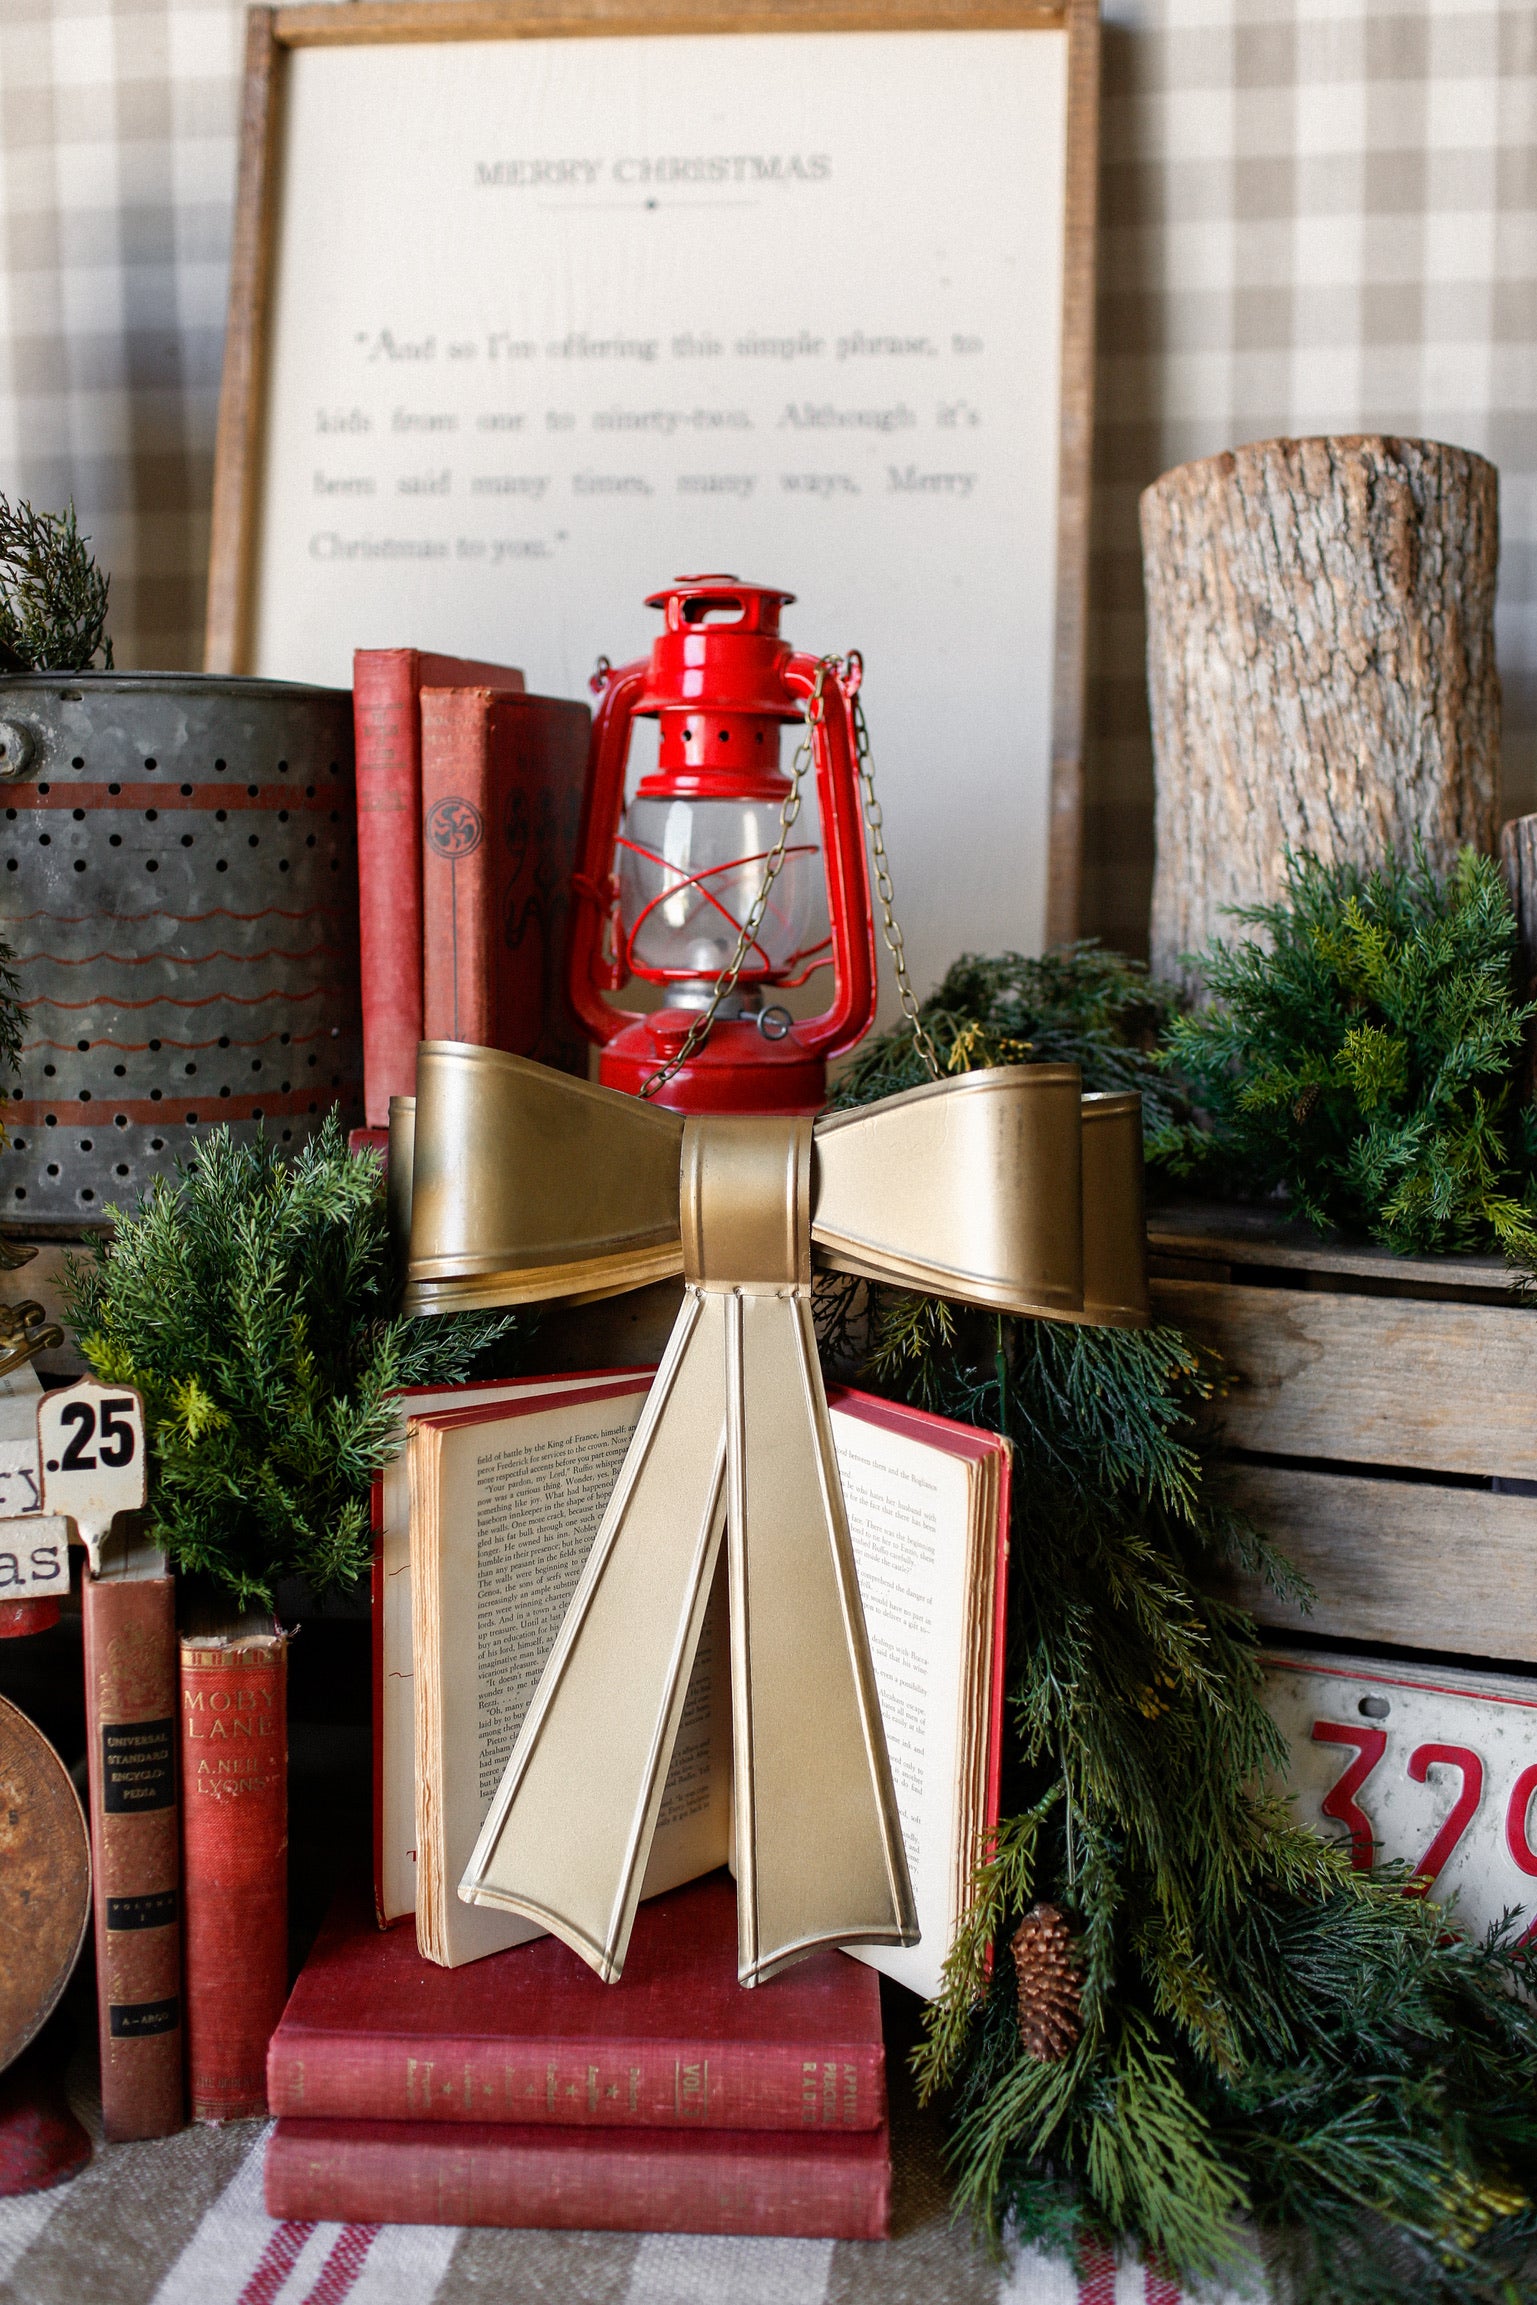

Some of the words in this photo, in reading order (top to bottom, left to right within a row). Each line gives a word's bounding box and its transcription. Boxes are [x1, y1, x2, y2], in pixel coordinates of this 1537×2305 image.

[475, 158, 602, 187] MERRY
[611, 153, 832, 185] CHRISTMAS
[447, 342, 478, 361] so
[488, 331, 537, 361] I'm
[546, 330, 659, 363] offering
[671, 330, 723, 357] this
[733, 330, 826, 361] simple
[835, 329, 938, 362] phrase,
[951, 334, 984, 355] to
[315, 406, 371, 433] kids
[391, 406, 459, 433] from
[475, 412, 526, 433] one
[545, 409, 577, 432] to
[776, 402, 916, 432] Although
[936, 401, 980, 430] it's
[313, 470, 377, 496] been
[396, 469, 452, 496] said
[470, 474, 549, 500] many
[571, 467, 655, 497] times,
[676, 473, 756, 500] many
[779, 473, 861, 499] ways,
[886, 463, 977, 498] Merry
[309, 530, 450, 560] Christmas
[455, 537, 487, 559] to
[46, 1397, 135, 1472] .25
[477, 1454, 493, 1465] field
[504, 1448, 523, 1459] battle
[534, 1443, 545, 1452] the
[547, 1440, 564, 1449] King
[477, 1466, 496, 1478] peror
[497, 1456, 529, 1471] Frederick
[530, 1455, 540, 1463] for
[541, 1450, 566, 1461] services
[576, 1444, 586, 1453] the
[587, 1440, 610, 1450] crown.
[611, 1436, 628, 1445] Now
[477, 1476, 495, 1486] more
[496, 1467, 529, 1482] respectful
[530, 1462, 554, 1474] accents
[555, 1458, 576, 1468] before
[577, 1455, 590, 1465] you
[591, 1450, 604, 1462] part
[477, 1498, 492, 1507] now
[494, 1494, 508, 1503] was
[516, 1486, 541, 1498] curious
[543, 1482, 563, 1491] thing.
[566, 1474, 595, 1486] Wonder,
[597, 1471, 610, 1481] yes.
[485, 1484, 505, 1493] "Your
[573, 1463, 593, 1474] Ruffio
[477, 1503, 512, 1517] something
[515, 1498, 528, 1508] like
[530, 1497, 542, 1507] joy.
[545, 1490, 564, 1501] What
[567, 1485, 580, 1496] had
[582, 1477, 614, 1493] happened
[477, 1515, 507, 1527] baseborn
[509, 1506, 543, 1520] innkeeper
[553, 1500, 564, 1509] the
[566, 1496, 585, 1506] shape
[477, 1537, 492, 1550] gled
[495, 1535, 505, 1544] his
[507, 1532, 516, 1541] fat
[519, 1527, 534, 1538] bulk
[537, 1520, 563, 1534] through
[566, 1518, 578, 1527] one
[580, 1512, 595, 1523] such
[477, 1548, 501, 1558] longer.
[518, 1535, 541, 1548] owned
[544, 1533, 554, 1542] his
[557, 1531, 570, 1539] inn.
[574, 1523, 597, 1535] Nobles
[478, 1579, 492, 1589] The
[495, 1573, 513, 1584] walls
[516, 1570, 532, 1579] were
[535, 1561, 569, 1575] beginning
[478, 1619, 496, 1630] lords.
[499, 1613, 514, 1624] And
[533, 1606, 550, 1616] town
[478, 1654, 518, 1670] imaginative
[520, 1650, 534, 1659] man
[537, 1645, 550, 1655] like
[184, 1687, 275, 1712] MOBY
[188, 1716, 275, 1739] LANE
[478, 1718, 492, 1730] laid
[513, 1711, 525, 1720] buy
[107, 1733, 168, 1748] UNIVERSAL
[107, 1749, 169, 1765] STANDARD
[122, 1788, 157, 1800] PEDIA
[197, 1777, 266, 1793] LYONS
[803, 2062, 816, 2123] RADIO
[823, 2062, 837, 2123] PRACTICAL
[843, 2062, 858, 2123] APPLIED
